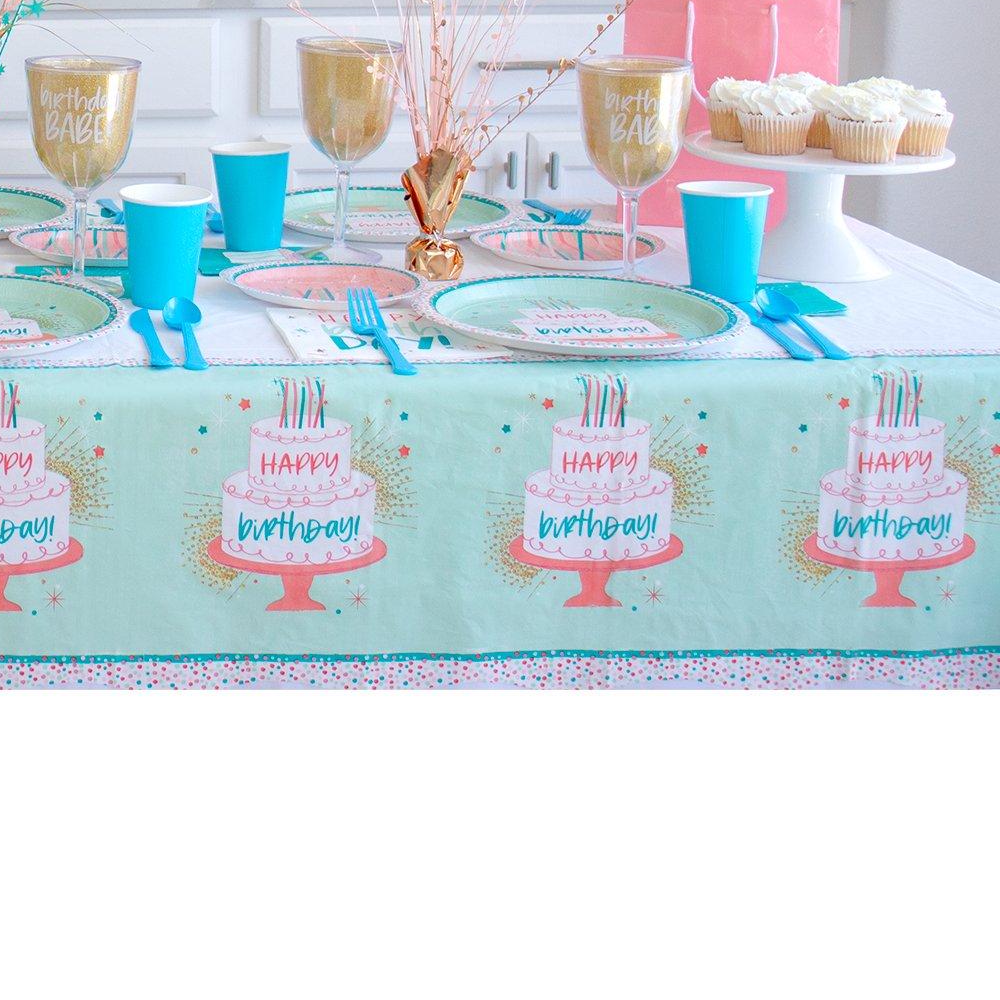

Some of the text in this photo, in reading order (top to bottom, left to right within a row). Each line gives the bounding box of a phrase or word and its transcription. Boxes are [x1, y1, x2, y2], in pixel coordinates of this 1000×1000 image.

[604, 86, 659, 114] birth
[609, 111, 662, 146] BAB
[260, 452, 339, 477] HAPPY
[562, 451, 638, 475] HAPPY
[858, 451, 933, 475] HAPPY
